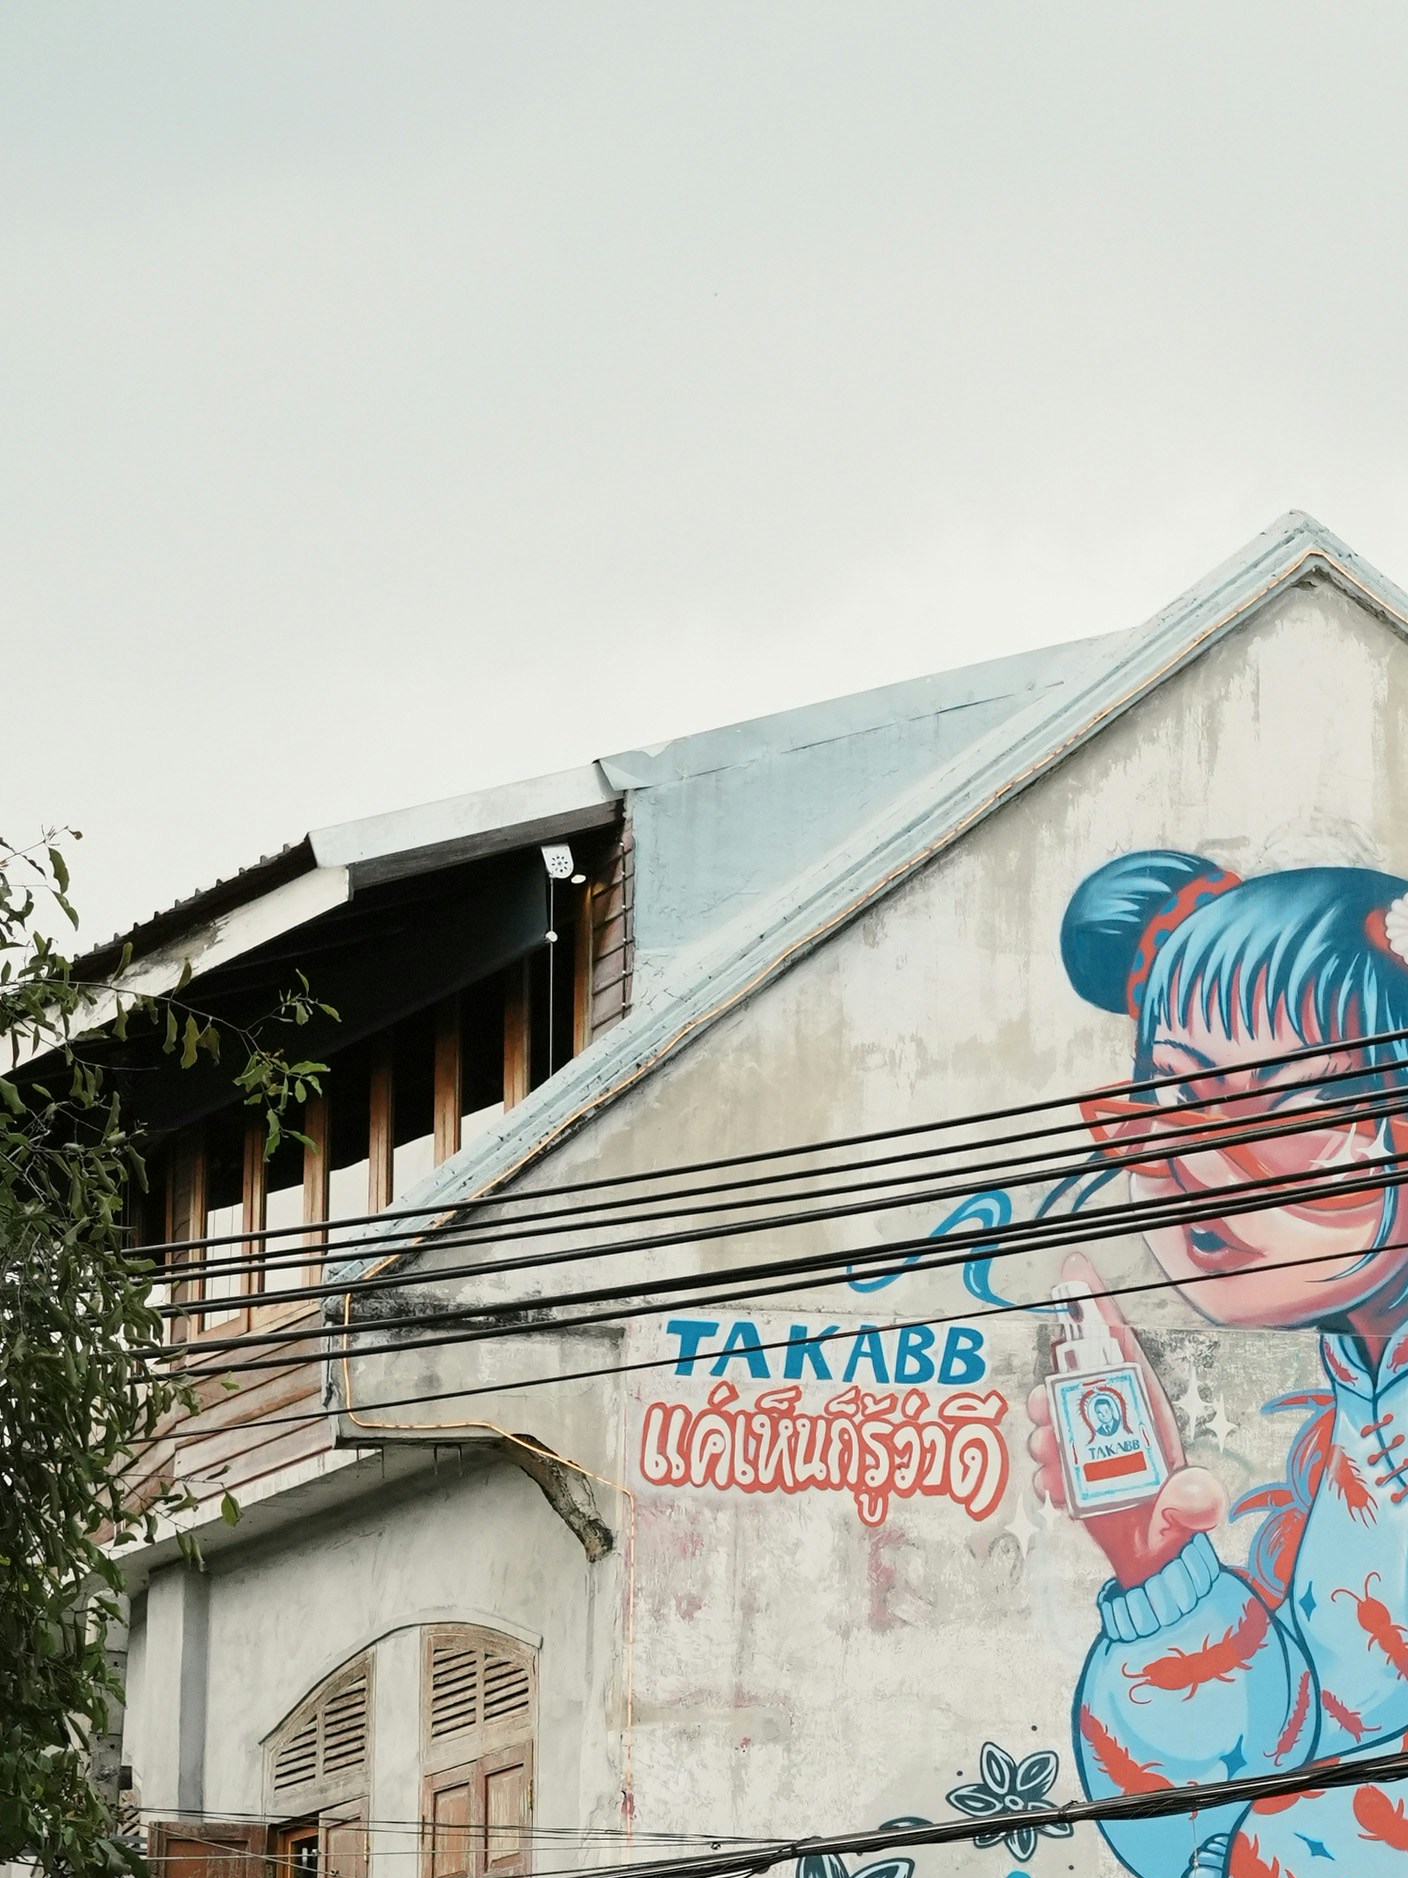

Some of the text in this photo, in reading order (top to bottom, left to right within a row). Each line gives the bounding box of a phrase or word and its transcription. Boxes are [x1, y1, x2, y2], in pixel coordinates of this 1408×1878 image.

[664, 1319, 988, 1385] TAKABB
[641, 1380, 1010, 1527] แค่เห็นก็รู้ว่าดี
